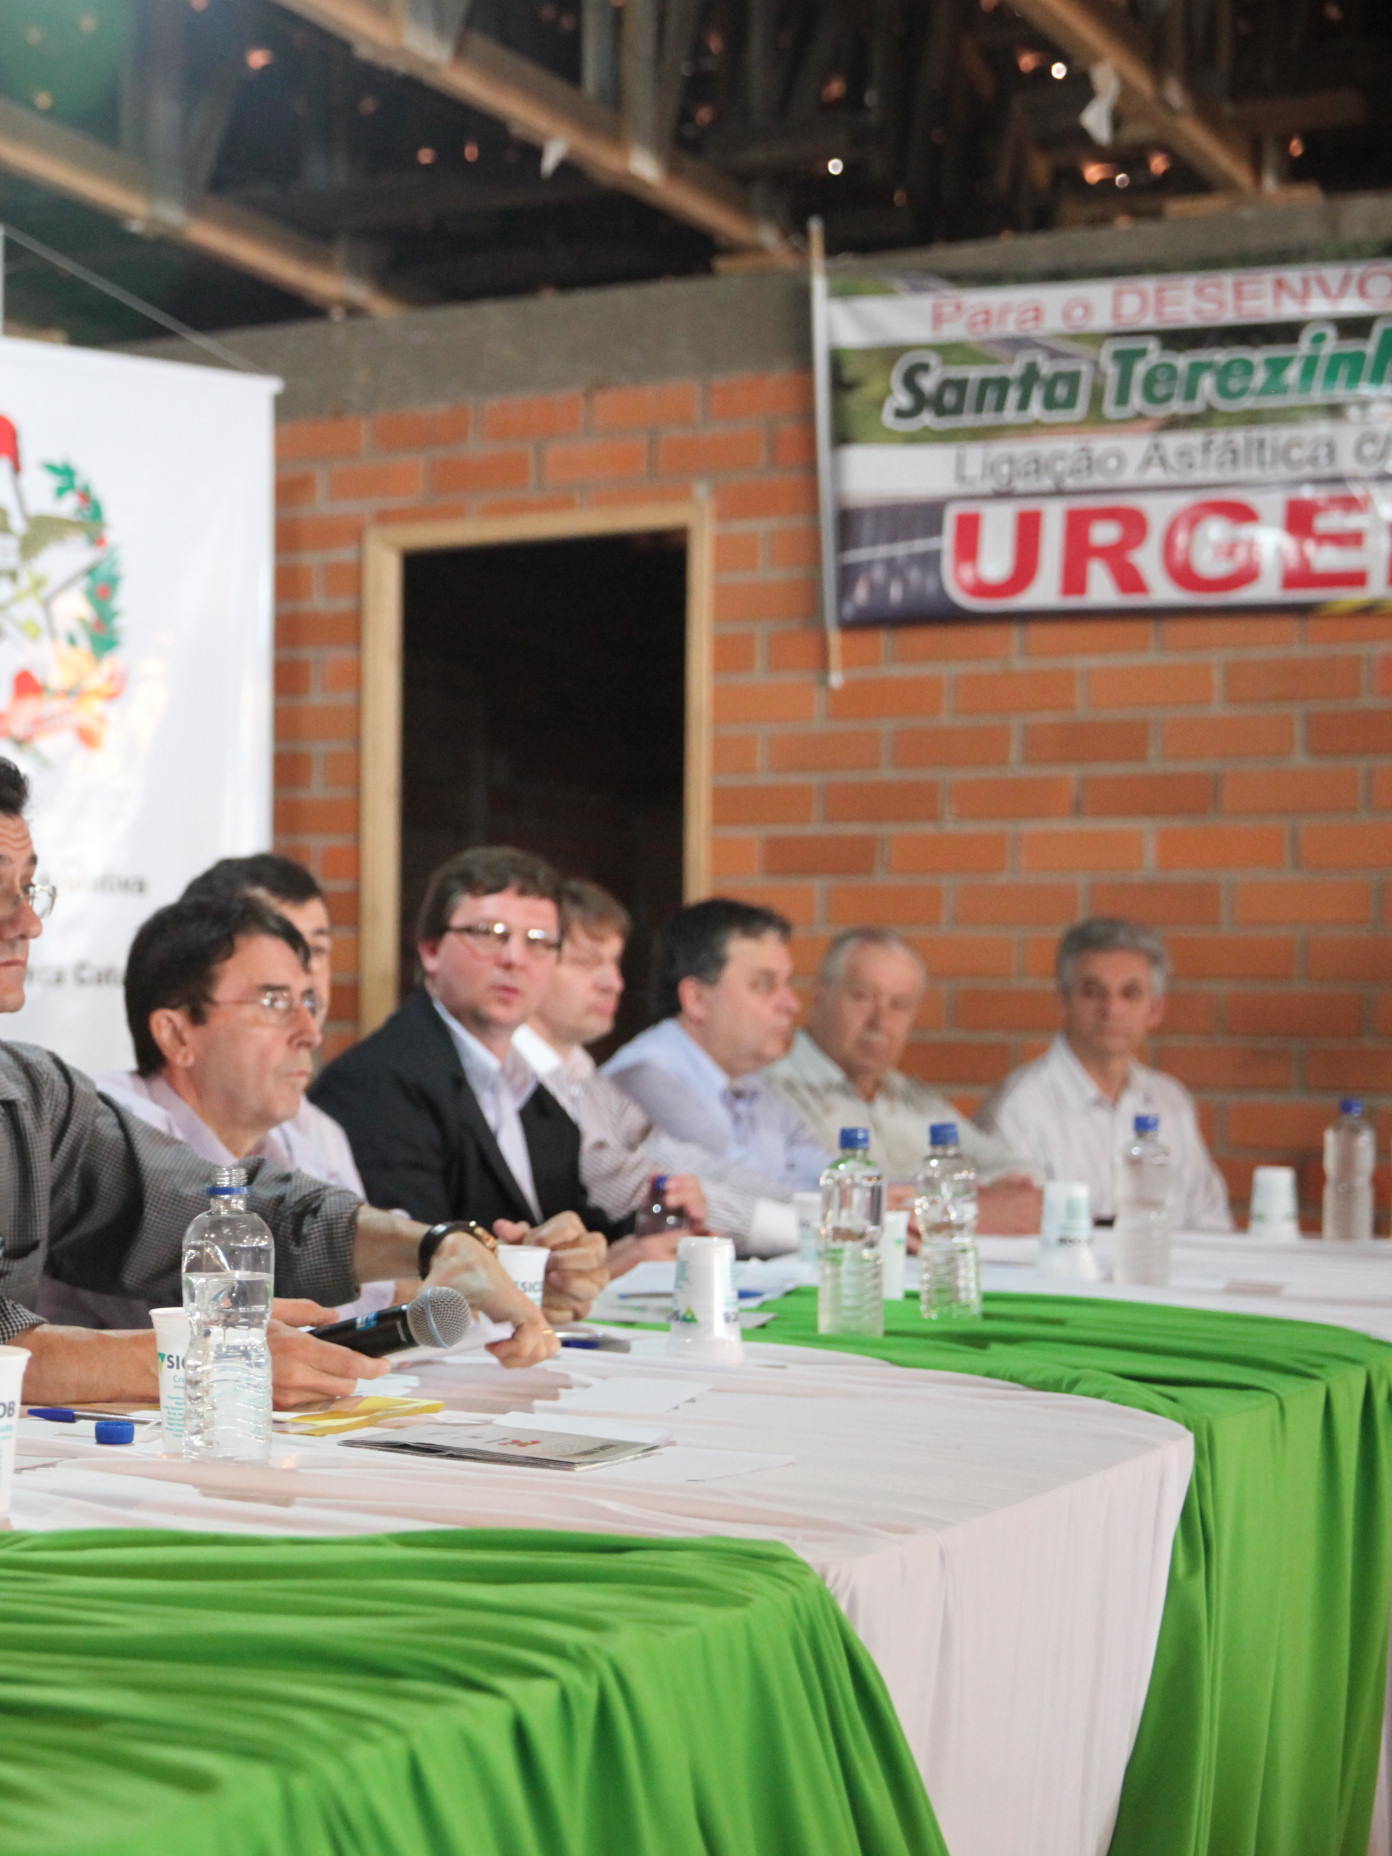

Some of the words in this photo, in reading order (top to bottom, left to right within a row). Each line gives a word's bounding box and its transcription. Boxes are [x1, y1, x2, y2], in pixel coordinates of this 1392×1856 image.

[931, 293, 1046, 336] Para
[1061, 296, 1094, 331] o
[892, 358, 1085, 422] Santa
[954, 441, 1127, 495] Ligação
[1135, 431, 1337, 478] Asfáltica
[953, 490, 1392, 599] URGE
